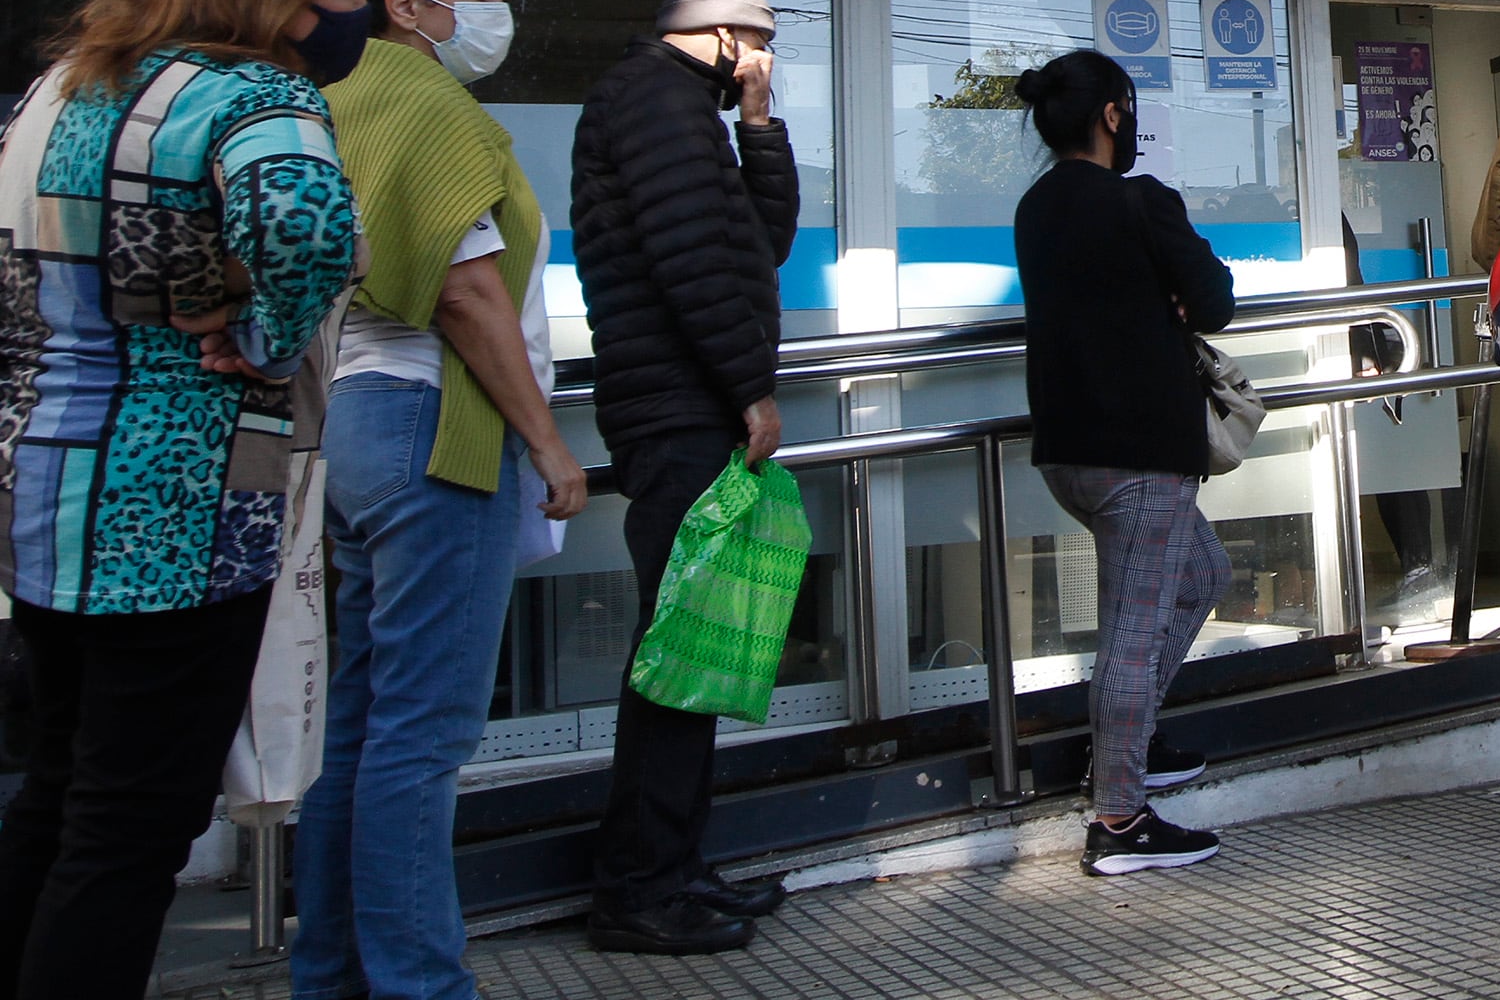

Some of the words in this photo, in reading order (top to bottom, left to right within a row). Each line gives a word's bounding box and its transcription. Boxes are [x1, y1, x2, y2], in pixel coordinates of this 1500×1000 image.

[1360, 66, 1393, 74] ACTIVEMOS
[1361, 76, 1384, 85] CONTRA
[1385, 77, 1396, 85] LAS
[1397, 77, 1429, 85] VIOLENCIAS
[1361, 87, 1370, 95] DE
[1365, 110, 1374, 119] ES
[1369, 149, 1398, 157] ANSES
